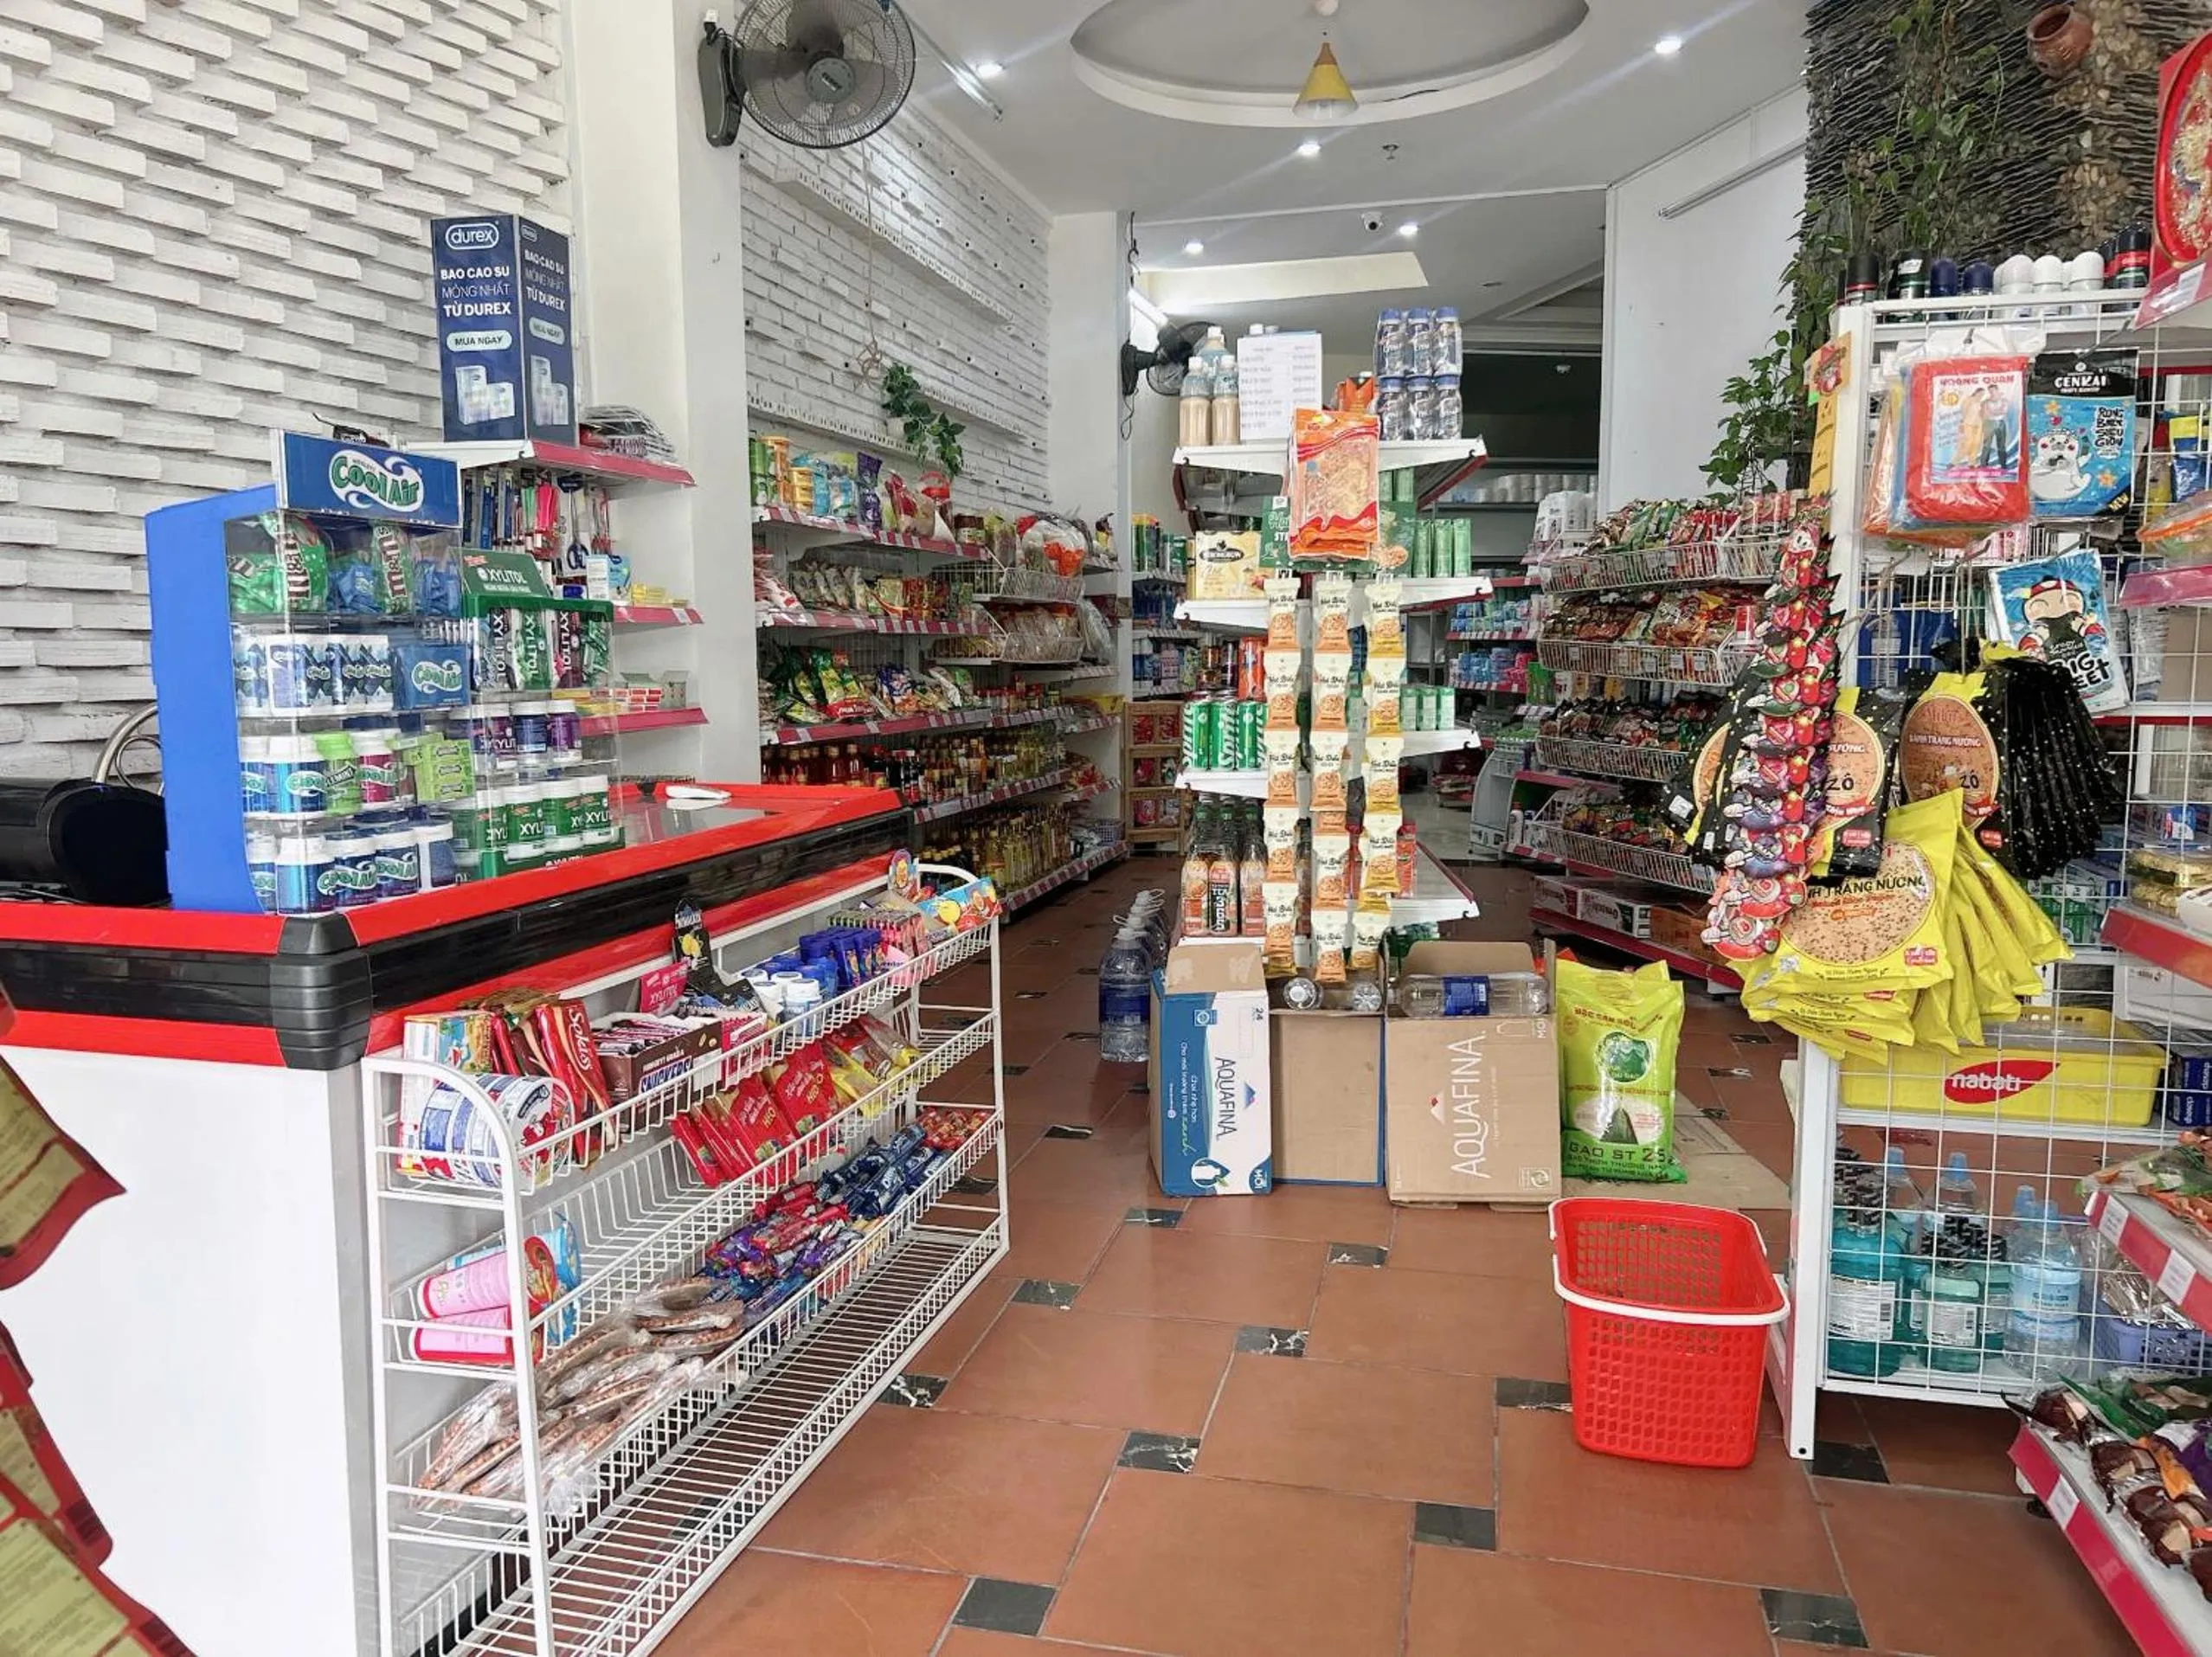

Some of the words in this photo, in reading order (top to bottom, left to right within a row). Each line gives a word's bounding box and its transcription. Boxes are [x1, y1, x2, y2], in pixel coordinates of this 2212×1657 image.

[451, 228, 495, 244] durex
[440, 267, 465, 280] BAO
[467, 267, 492, 279] CAO
[494, 266, 510, 278] SU
[443, 300, 462, 318] TỪ
[464, 302, 511, 317] DUREX
[454, 337, 476, 346] MUA
[478, 335, 503, 345] NGAY
[524, 614, 539, 675] XYLITOL
[559, 611, 572, 671] XYLITOL
[1255, 1006, 1264, 1023] 24
[1951, 1071, 2022, 1093] nabati
[1215, 1056, 1238, 1140] AQUAFINA
[1447, 1033, 1493, 1179] AQUAFINA
[1612, 1148, 1636, 1161] ST
